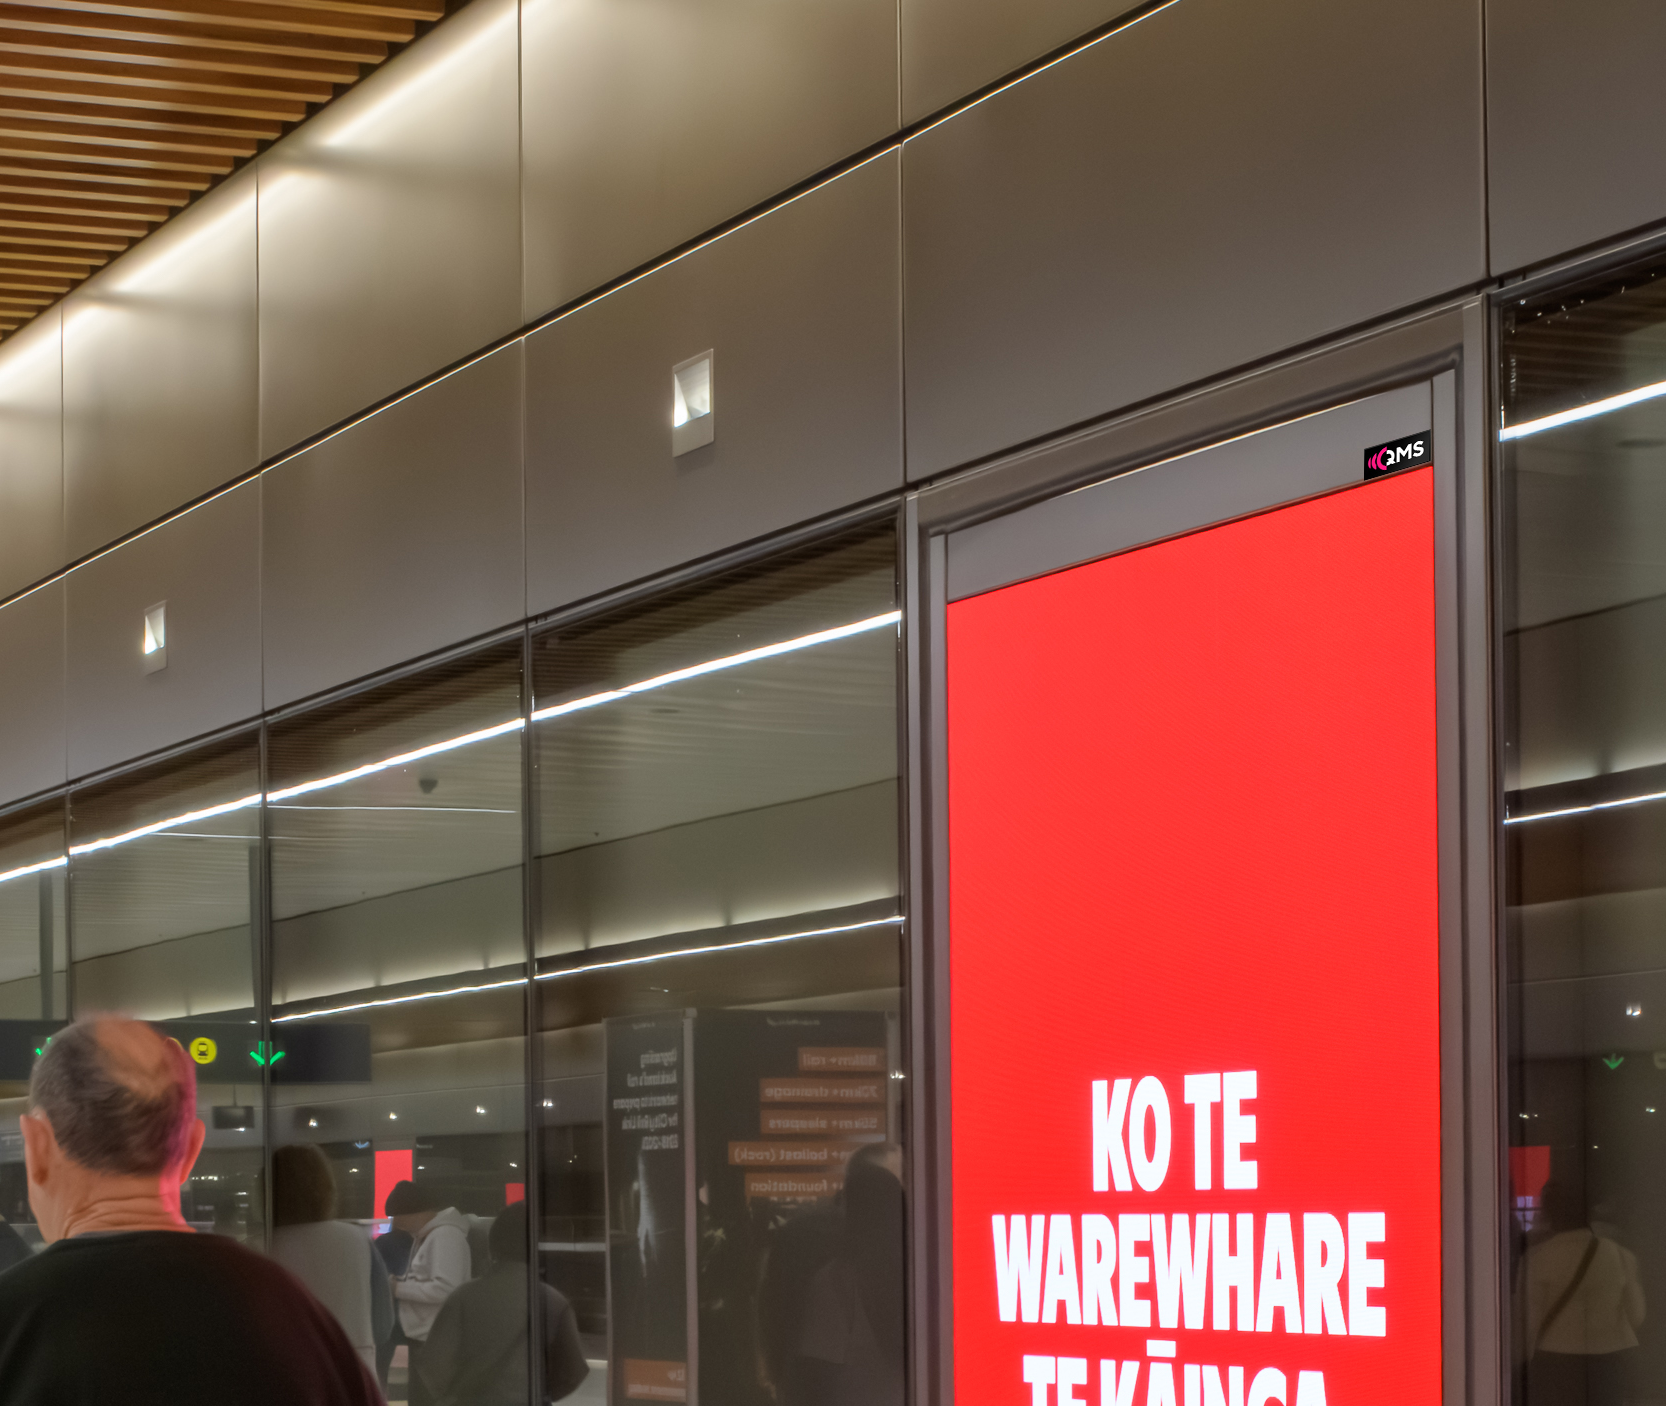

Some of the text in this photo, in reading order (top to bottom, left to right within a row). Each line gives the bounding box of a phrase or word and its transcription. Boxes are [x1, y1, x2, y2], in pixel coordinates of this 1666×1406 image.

[1376, 440, 1425, 471] QMS
[1092, 1070, 1258, 1192] KO TE
[992, 1212, 1386, 1337] WAREWHARE
